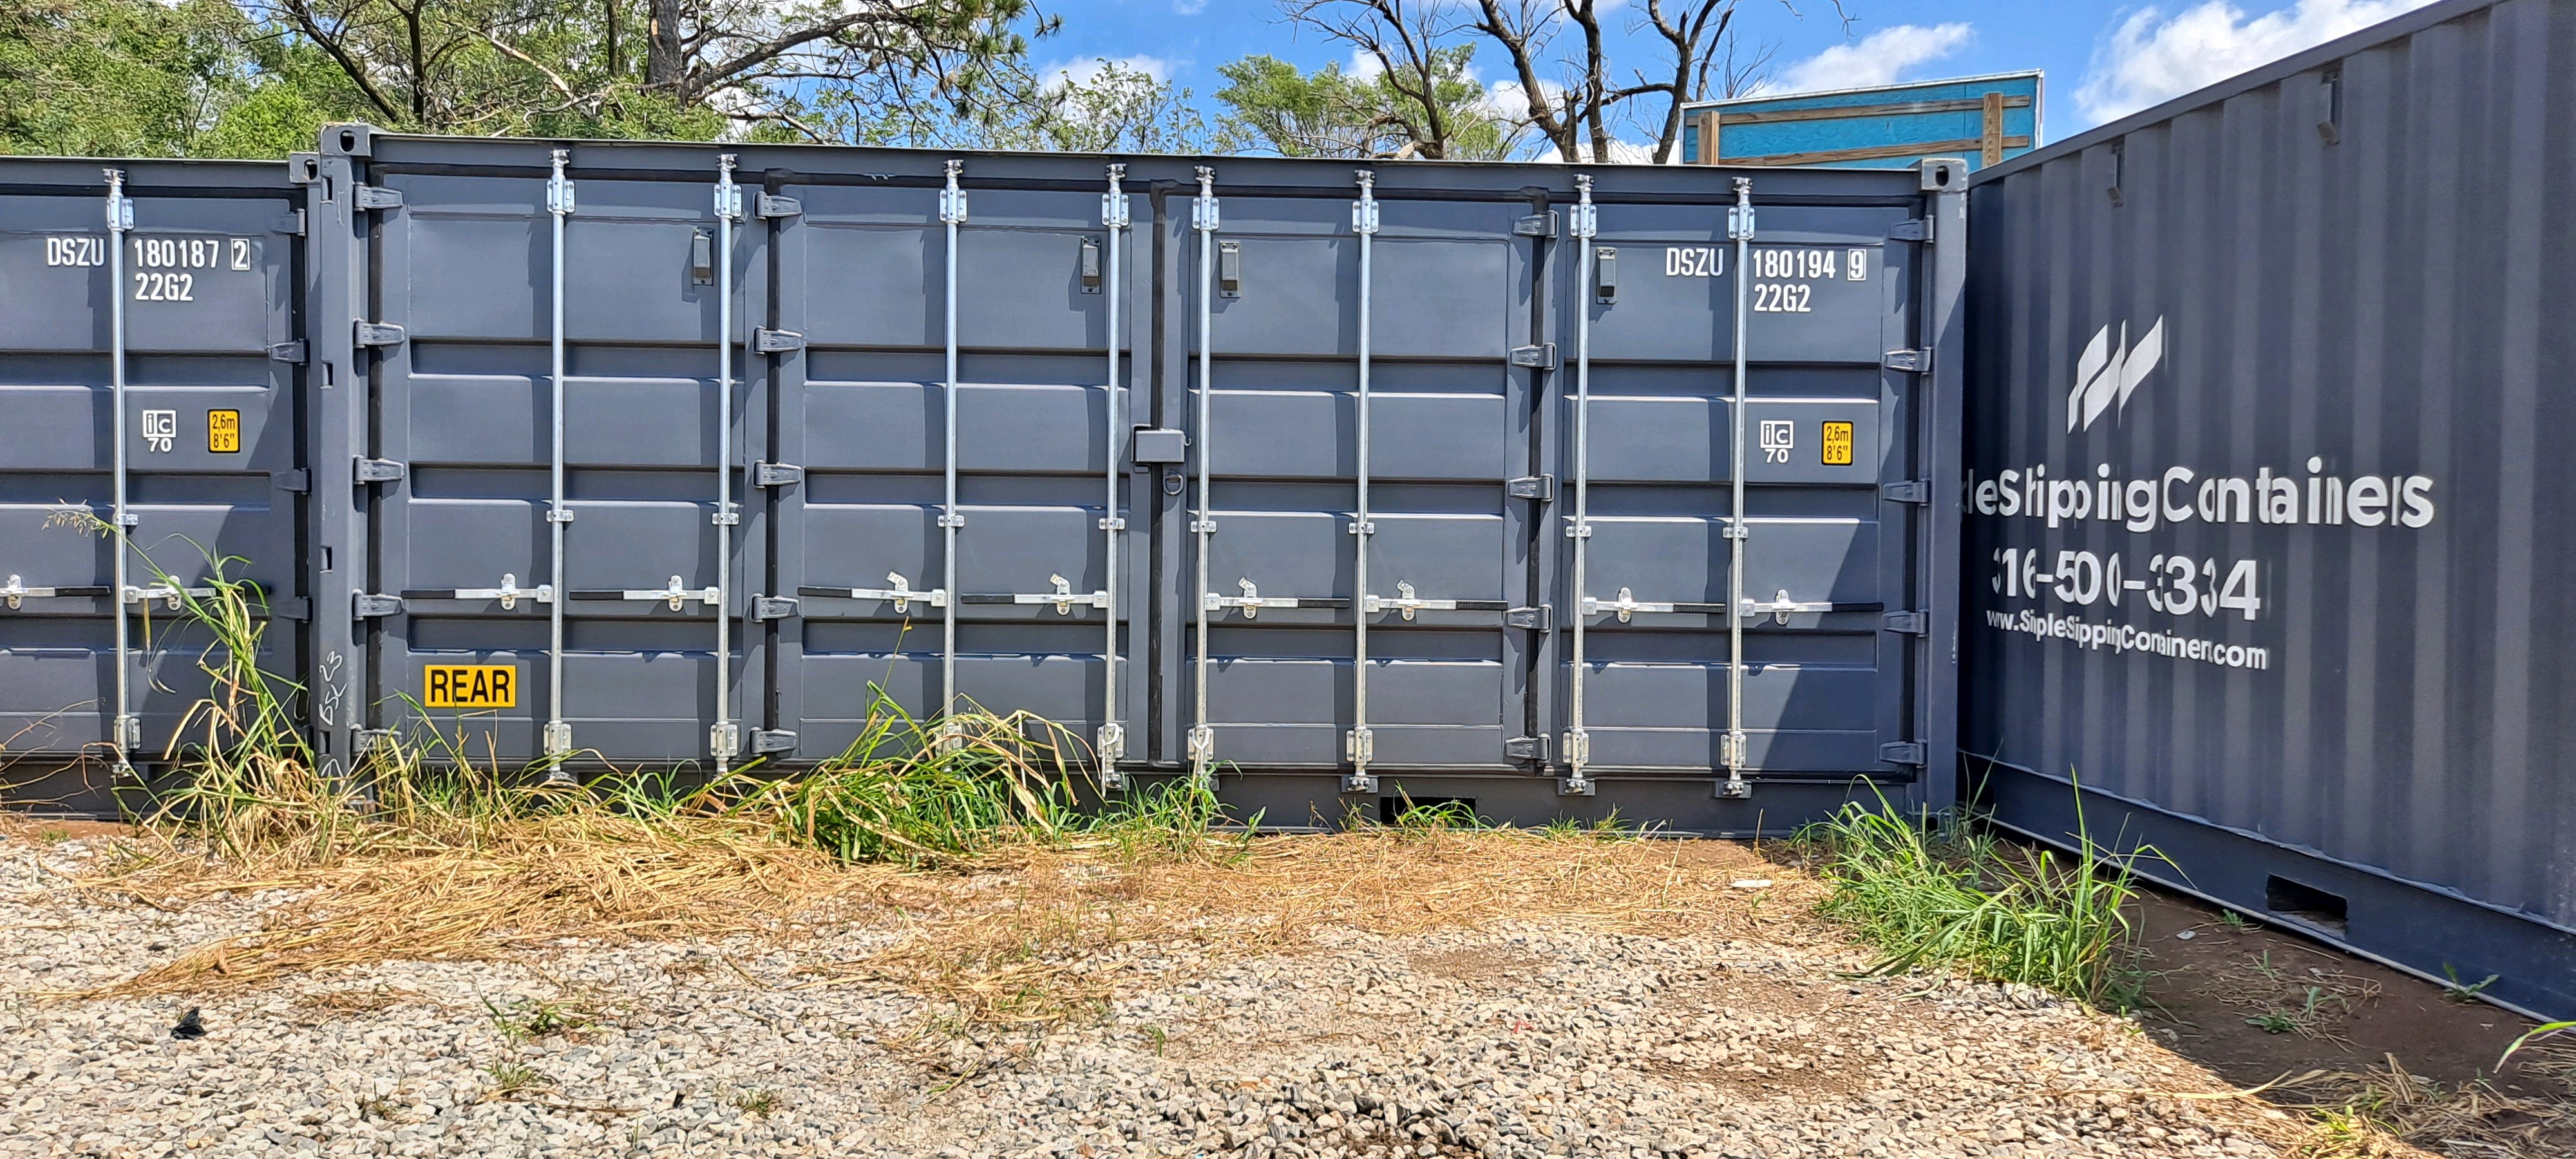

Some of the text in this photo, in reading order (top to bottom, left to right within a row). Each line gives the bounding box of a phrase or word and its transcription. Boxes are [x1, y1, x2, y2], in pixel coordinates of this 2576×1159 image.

[47, 238, 247, 269] DSZU 180187 2
[1666, 247, 1864, 279] DSZU 180194 9
[135, 272, 193, 301] 22G2
[1754, 283, 1811, 312] 22G2
[213, 414, 235, 432] 2,6m
[213, 433, 235, 448] 8'6"
[1826, 426, 1849, 444] 2,6m
[147, 437, 173, 453] 70
[1826, 445, 1848, 460] 8'6"
[1765, 448, 1789, 464] 70
[431, 669, 510, 703] REAR
